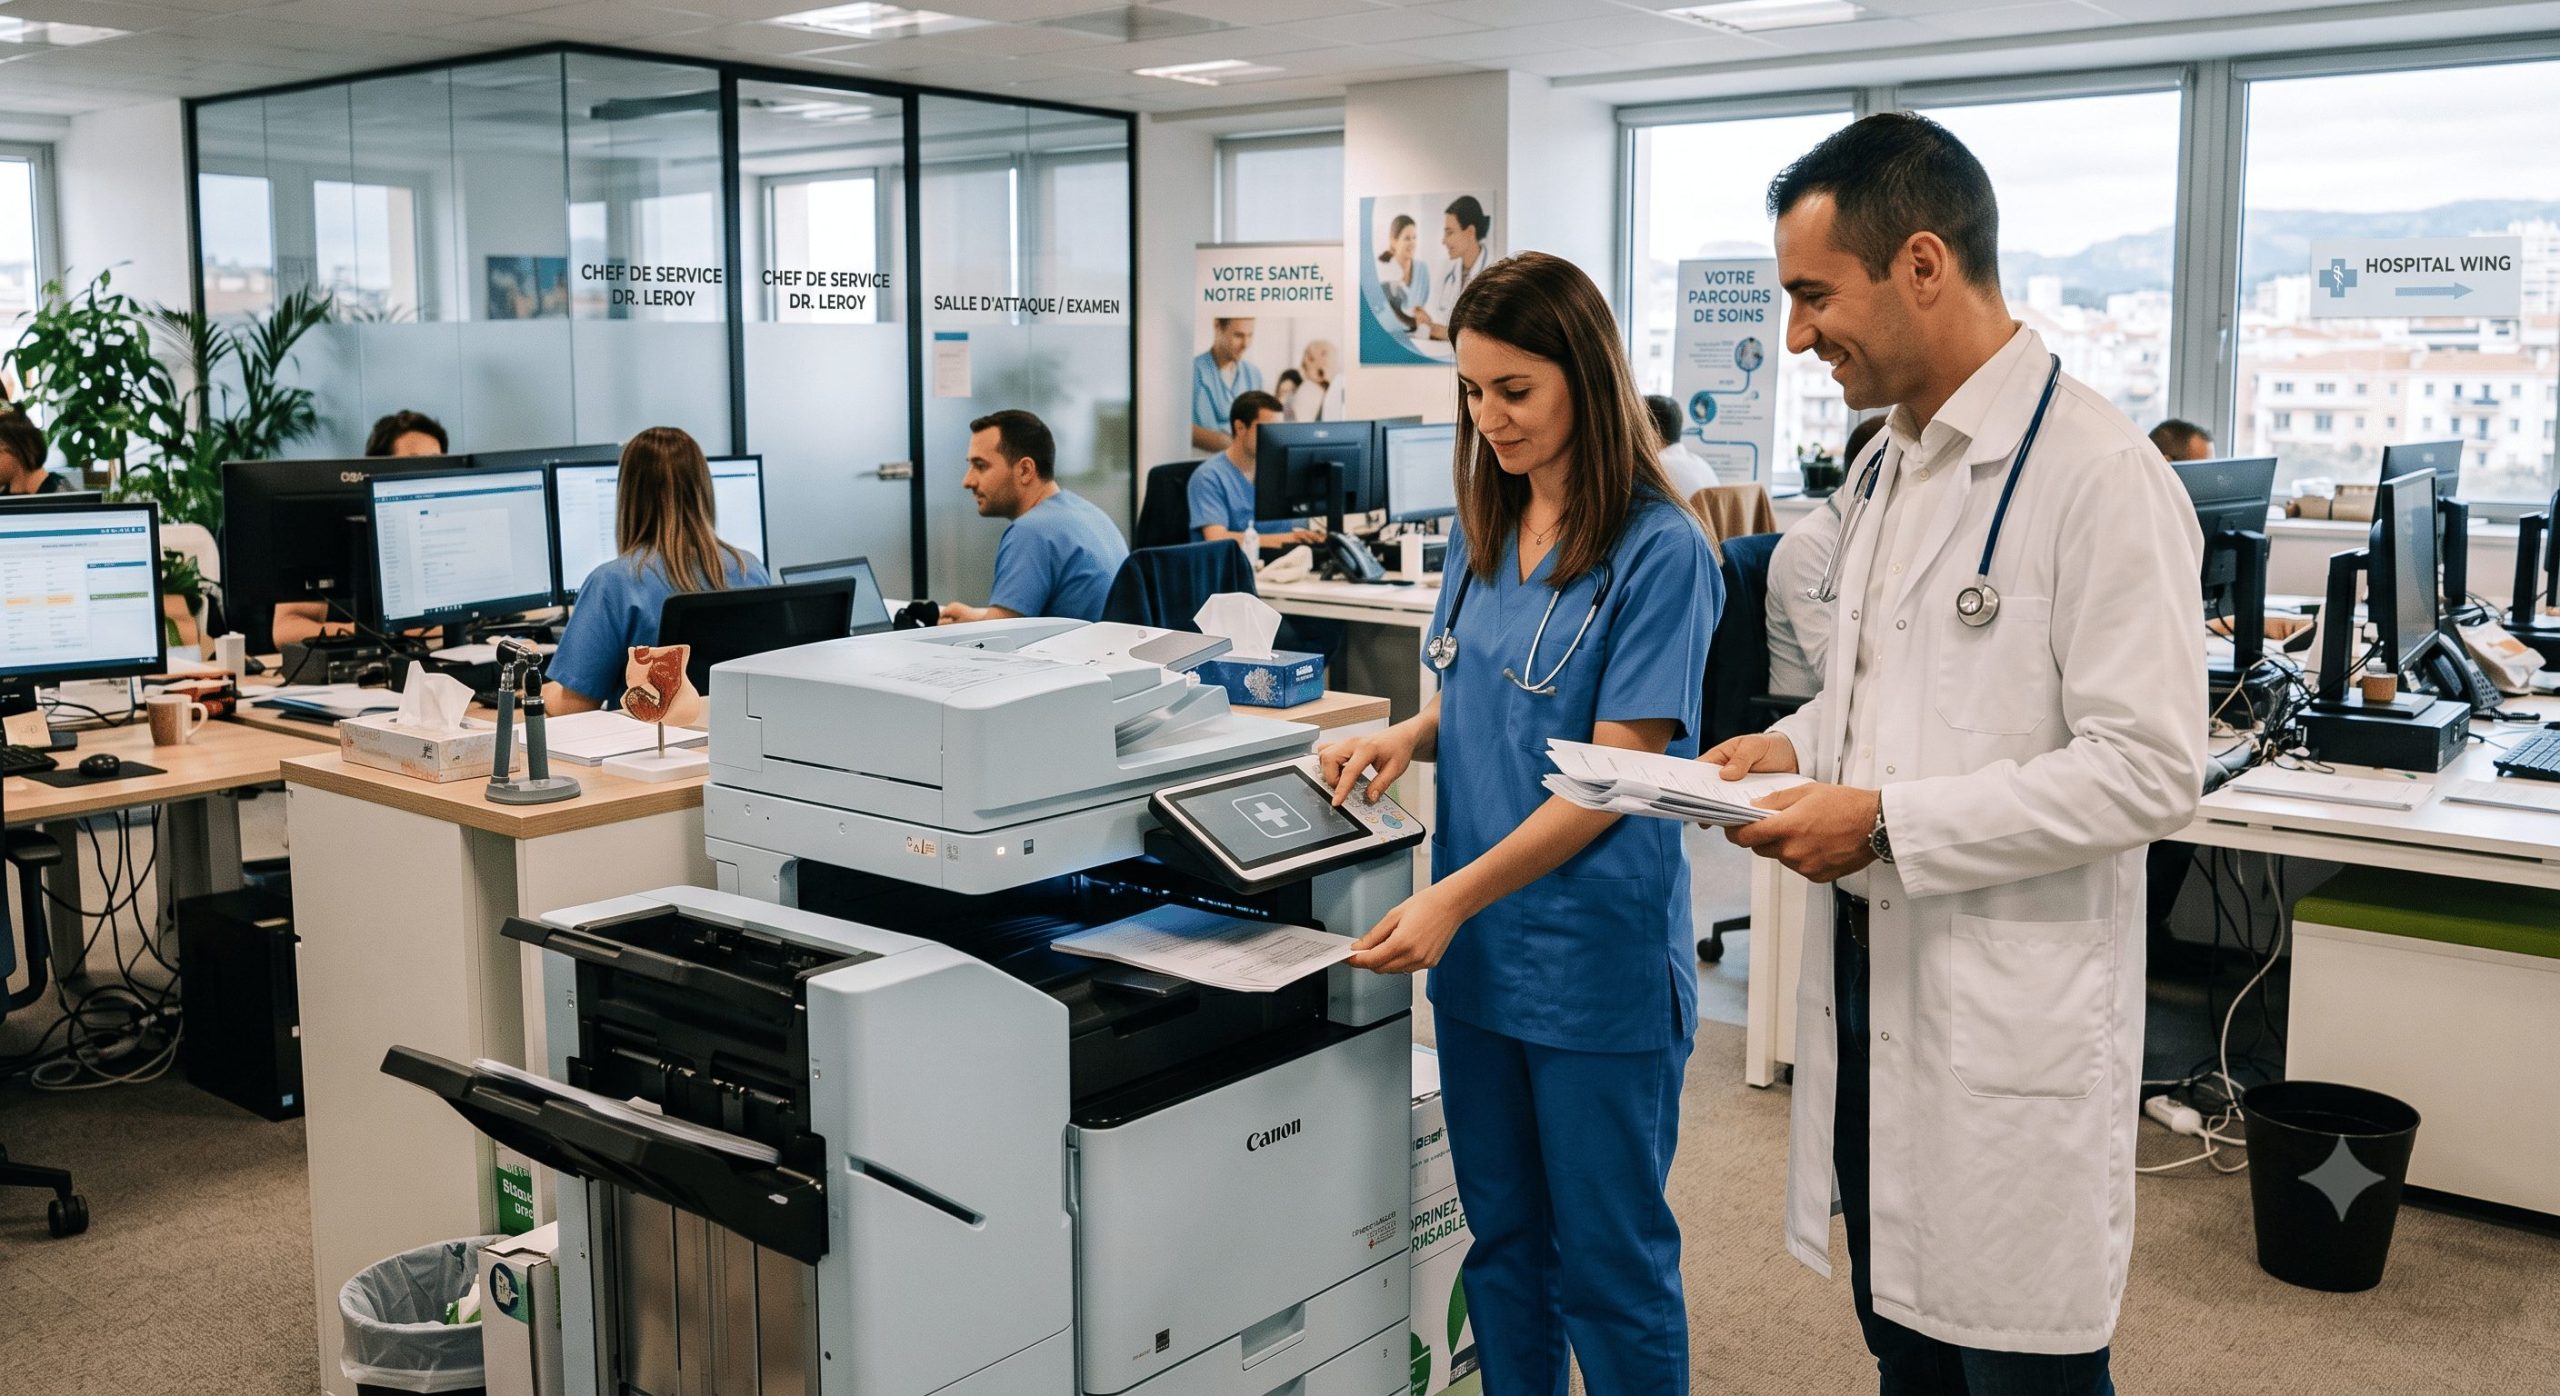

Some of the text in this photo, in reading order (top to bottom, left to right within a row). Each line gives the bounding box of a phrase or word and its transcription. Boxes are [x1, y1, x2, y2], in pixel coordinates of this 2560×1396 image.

[1212, 262, 1324, 282] VOTRE SANTÉ,
[2365, 255, 2511, 274] HOSPITAL WING
[581, 264, 723, 284] CHEF DE SERVICE
[762, 270, 890, 288] CHEF DE SERVICE
[1704, 270, 1756, 285] VOTRE
[612, 289, 696, 306] DR. LEROY
[1204, 282, 1334, 301] NOTRE PRIORITÉ
[1688, 289, 1771, 303] PARCOURS
[789, 293, 866, 310] DR. LEROY
[934, 295, 1120, 315] SALLE D'ATTAQUE / EXAMEN
[1694, 308, 1764, 323] DE SOINS
[1246, 1118, 1301, 1152] Canon
